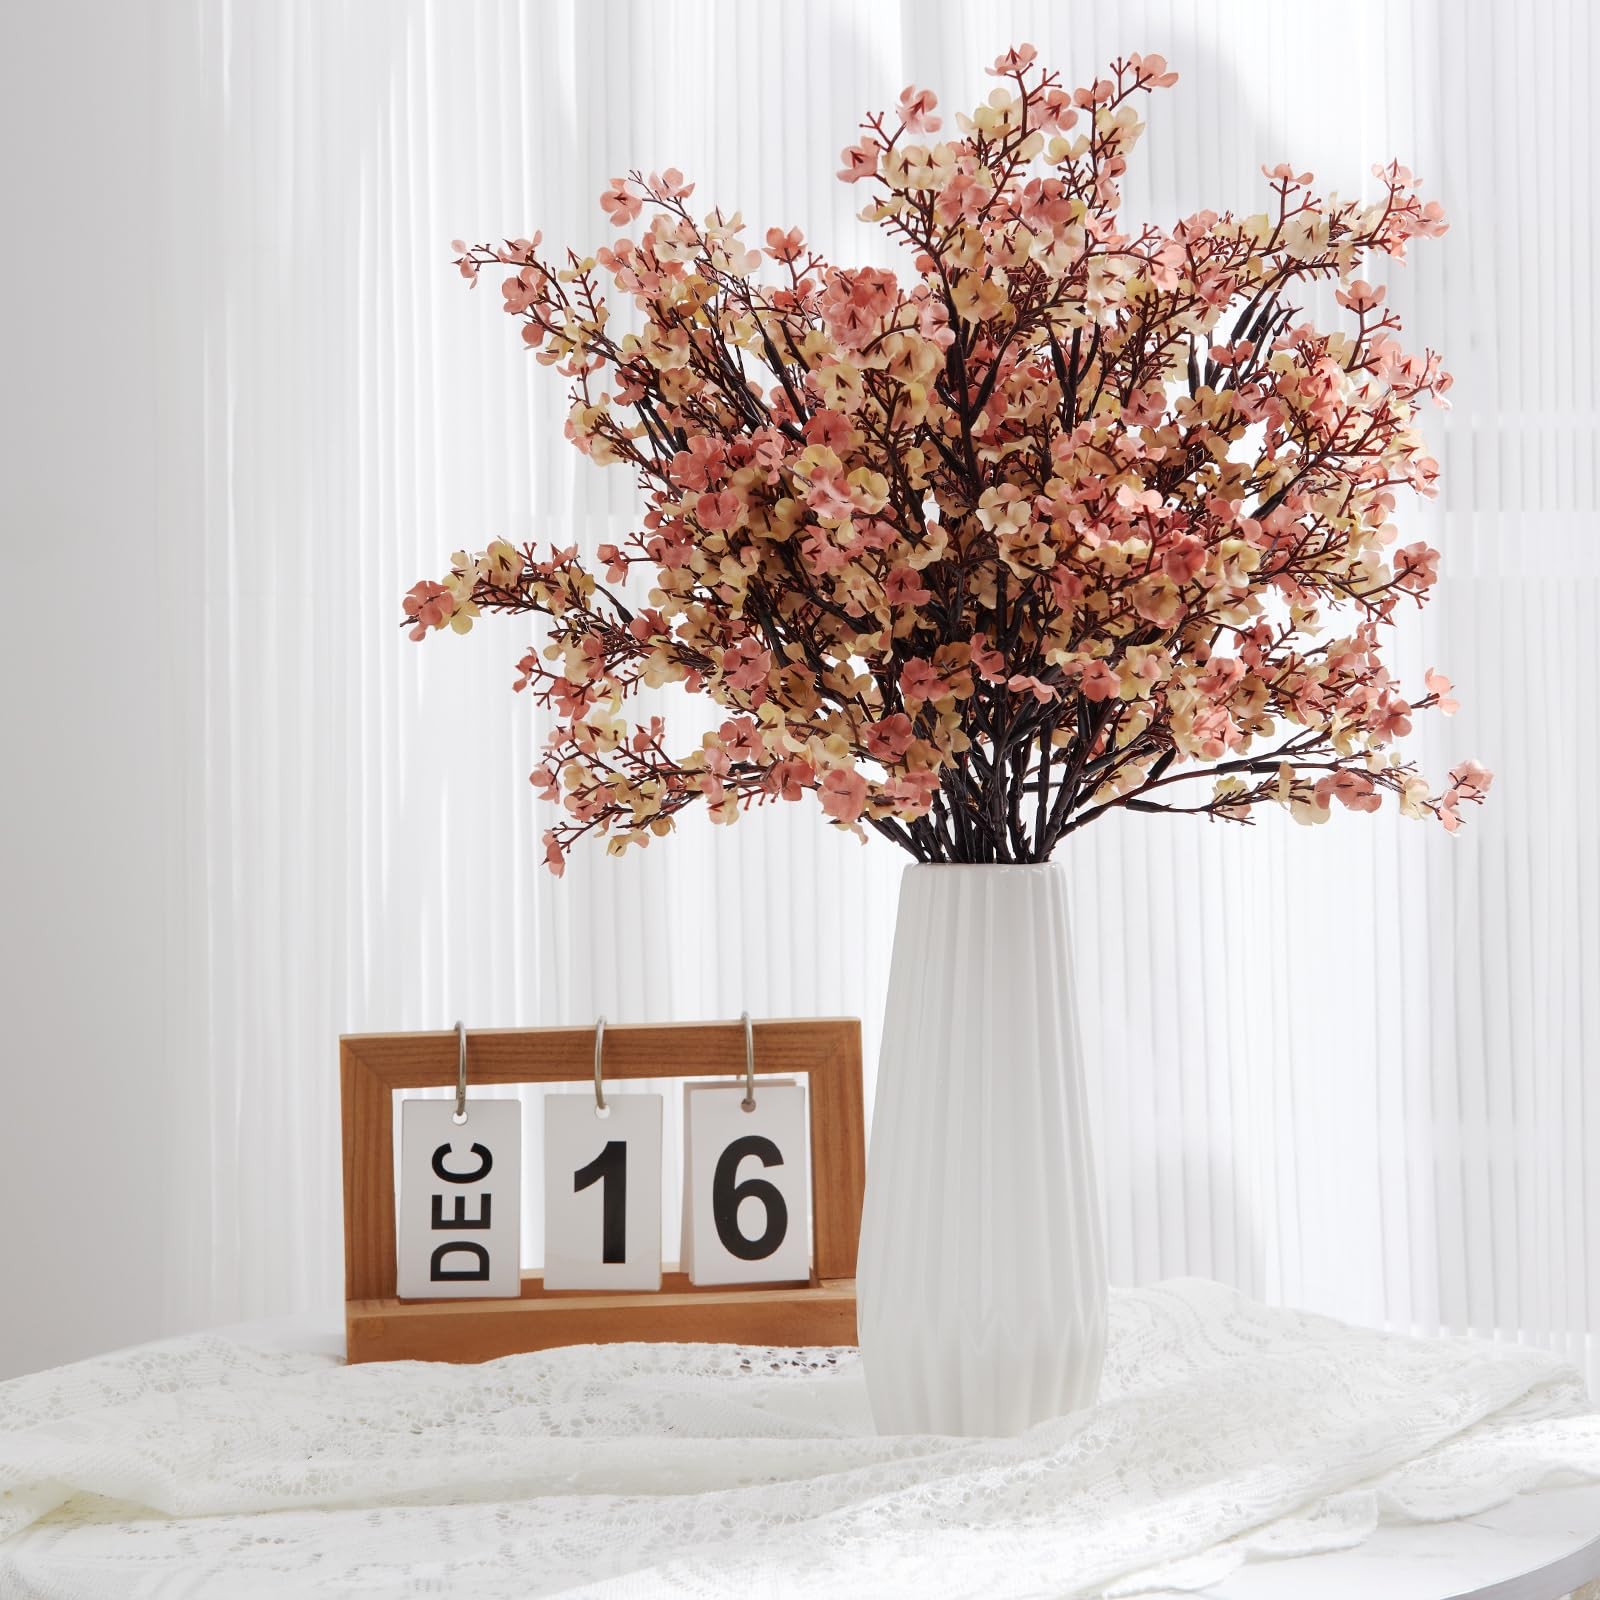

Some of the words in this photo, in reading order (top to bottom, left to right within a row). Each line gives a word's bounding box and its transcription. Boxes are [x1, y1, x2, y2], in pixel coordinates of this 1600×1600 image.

[430, 1142, 493, 1282] DEC
[574, 1140, 627, 1265] 1
[712, 1135, 788, 1261] 6
